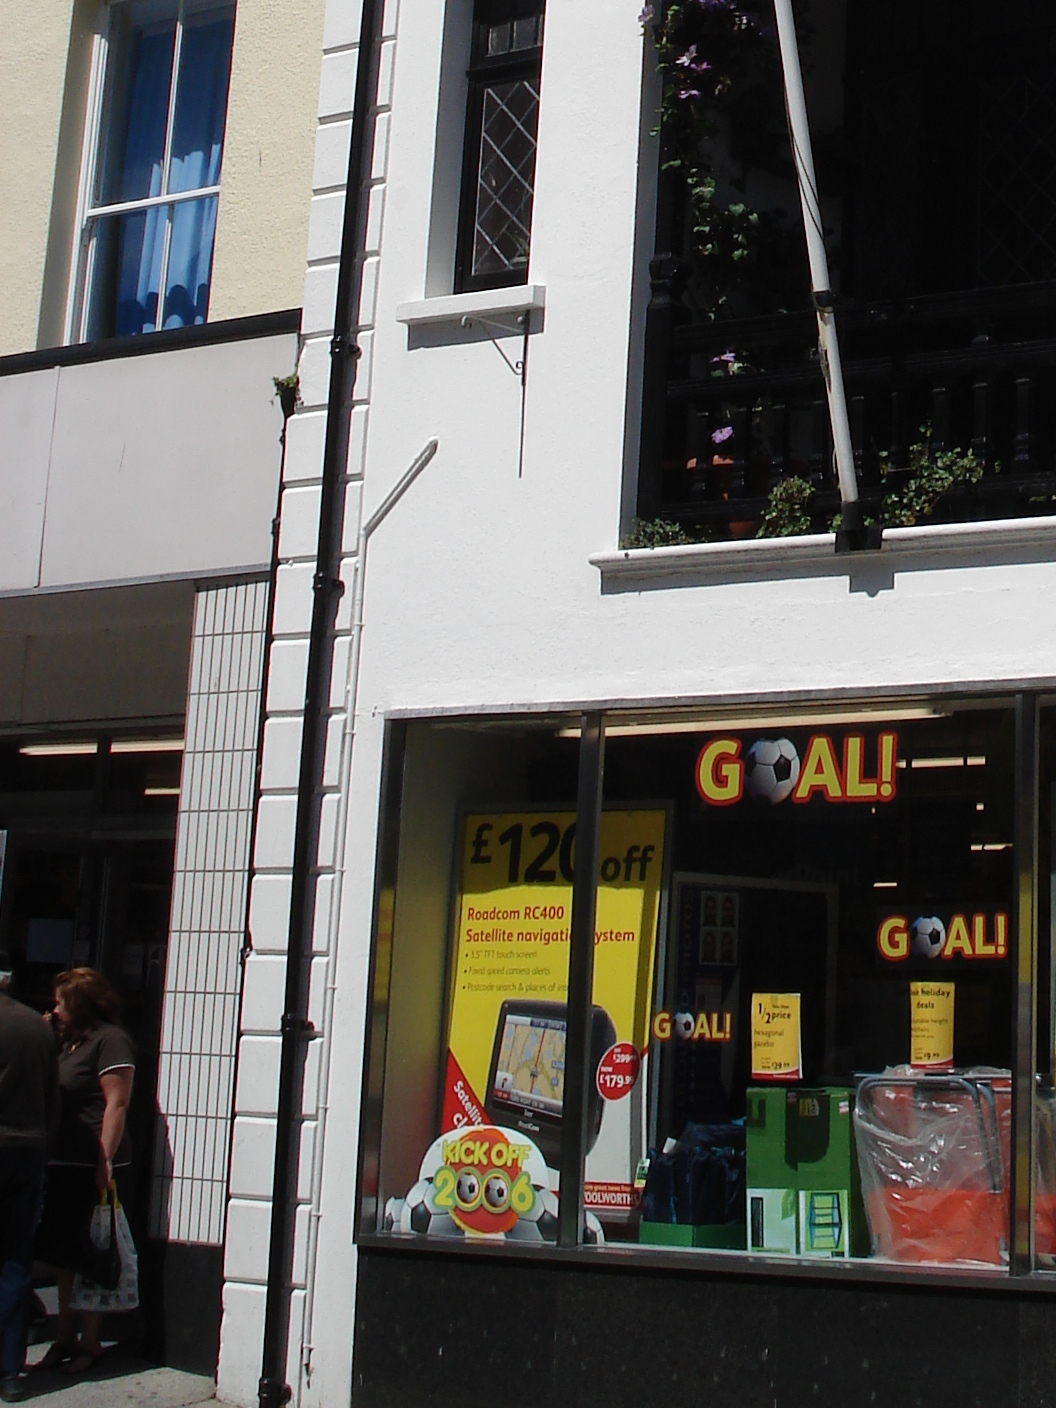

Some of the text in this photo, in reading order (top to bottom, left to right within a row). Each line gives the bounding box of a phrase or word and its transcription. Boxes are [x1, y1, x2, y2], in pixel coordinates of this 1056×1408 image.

[695, 732, 898, 806] GOAL!
[601, 845, 655, 882] off
[467, 906, 565, 921] Roadcom RC400
[466, 928, 635, 946] Satellite navigati ystem
[877, 913, 1008, 962] GOAL!
[497, 951, 514, 959] touch
[487, 968, 505, 976] speed
[532, 967, 550, 975] alerts
[496, 983, 516, 991] search
[525, 983, 547, 993] places
[548, 982, 556, 991] of
[921, 988, 950, 998] holiday
[916, 1001, 934, 1009] deals
[771, 1012, 791, 1021] price
[652, 1010, 732, 1043] GOAL!
[754, 1029, 784, 1038] hexagonal
[442, 1139, 532, 1168] KICK OFF
[433, 1166, 536, 1213] 2006
[584, 1192, 639, 1205] OOLWORTHS
